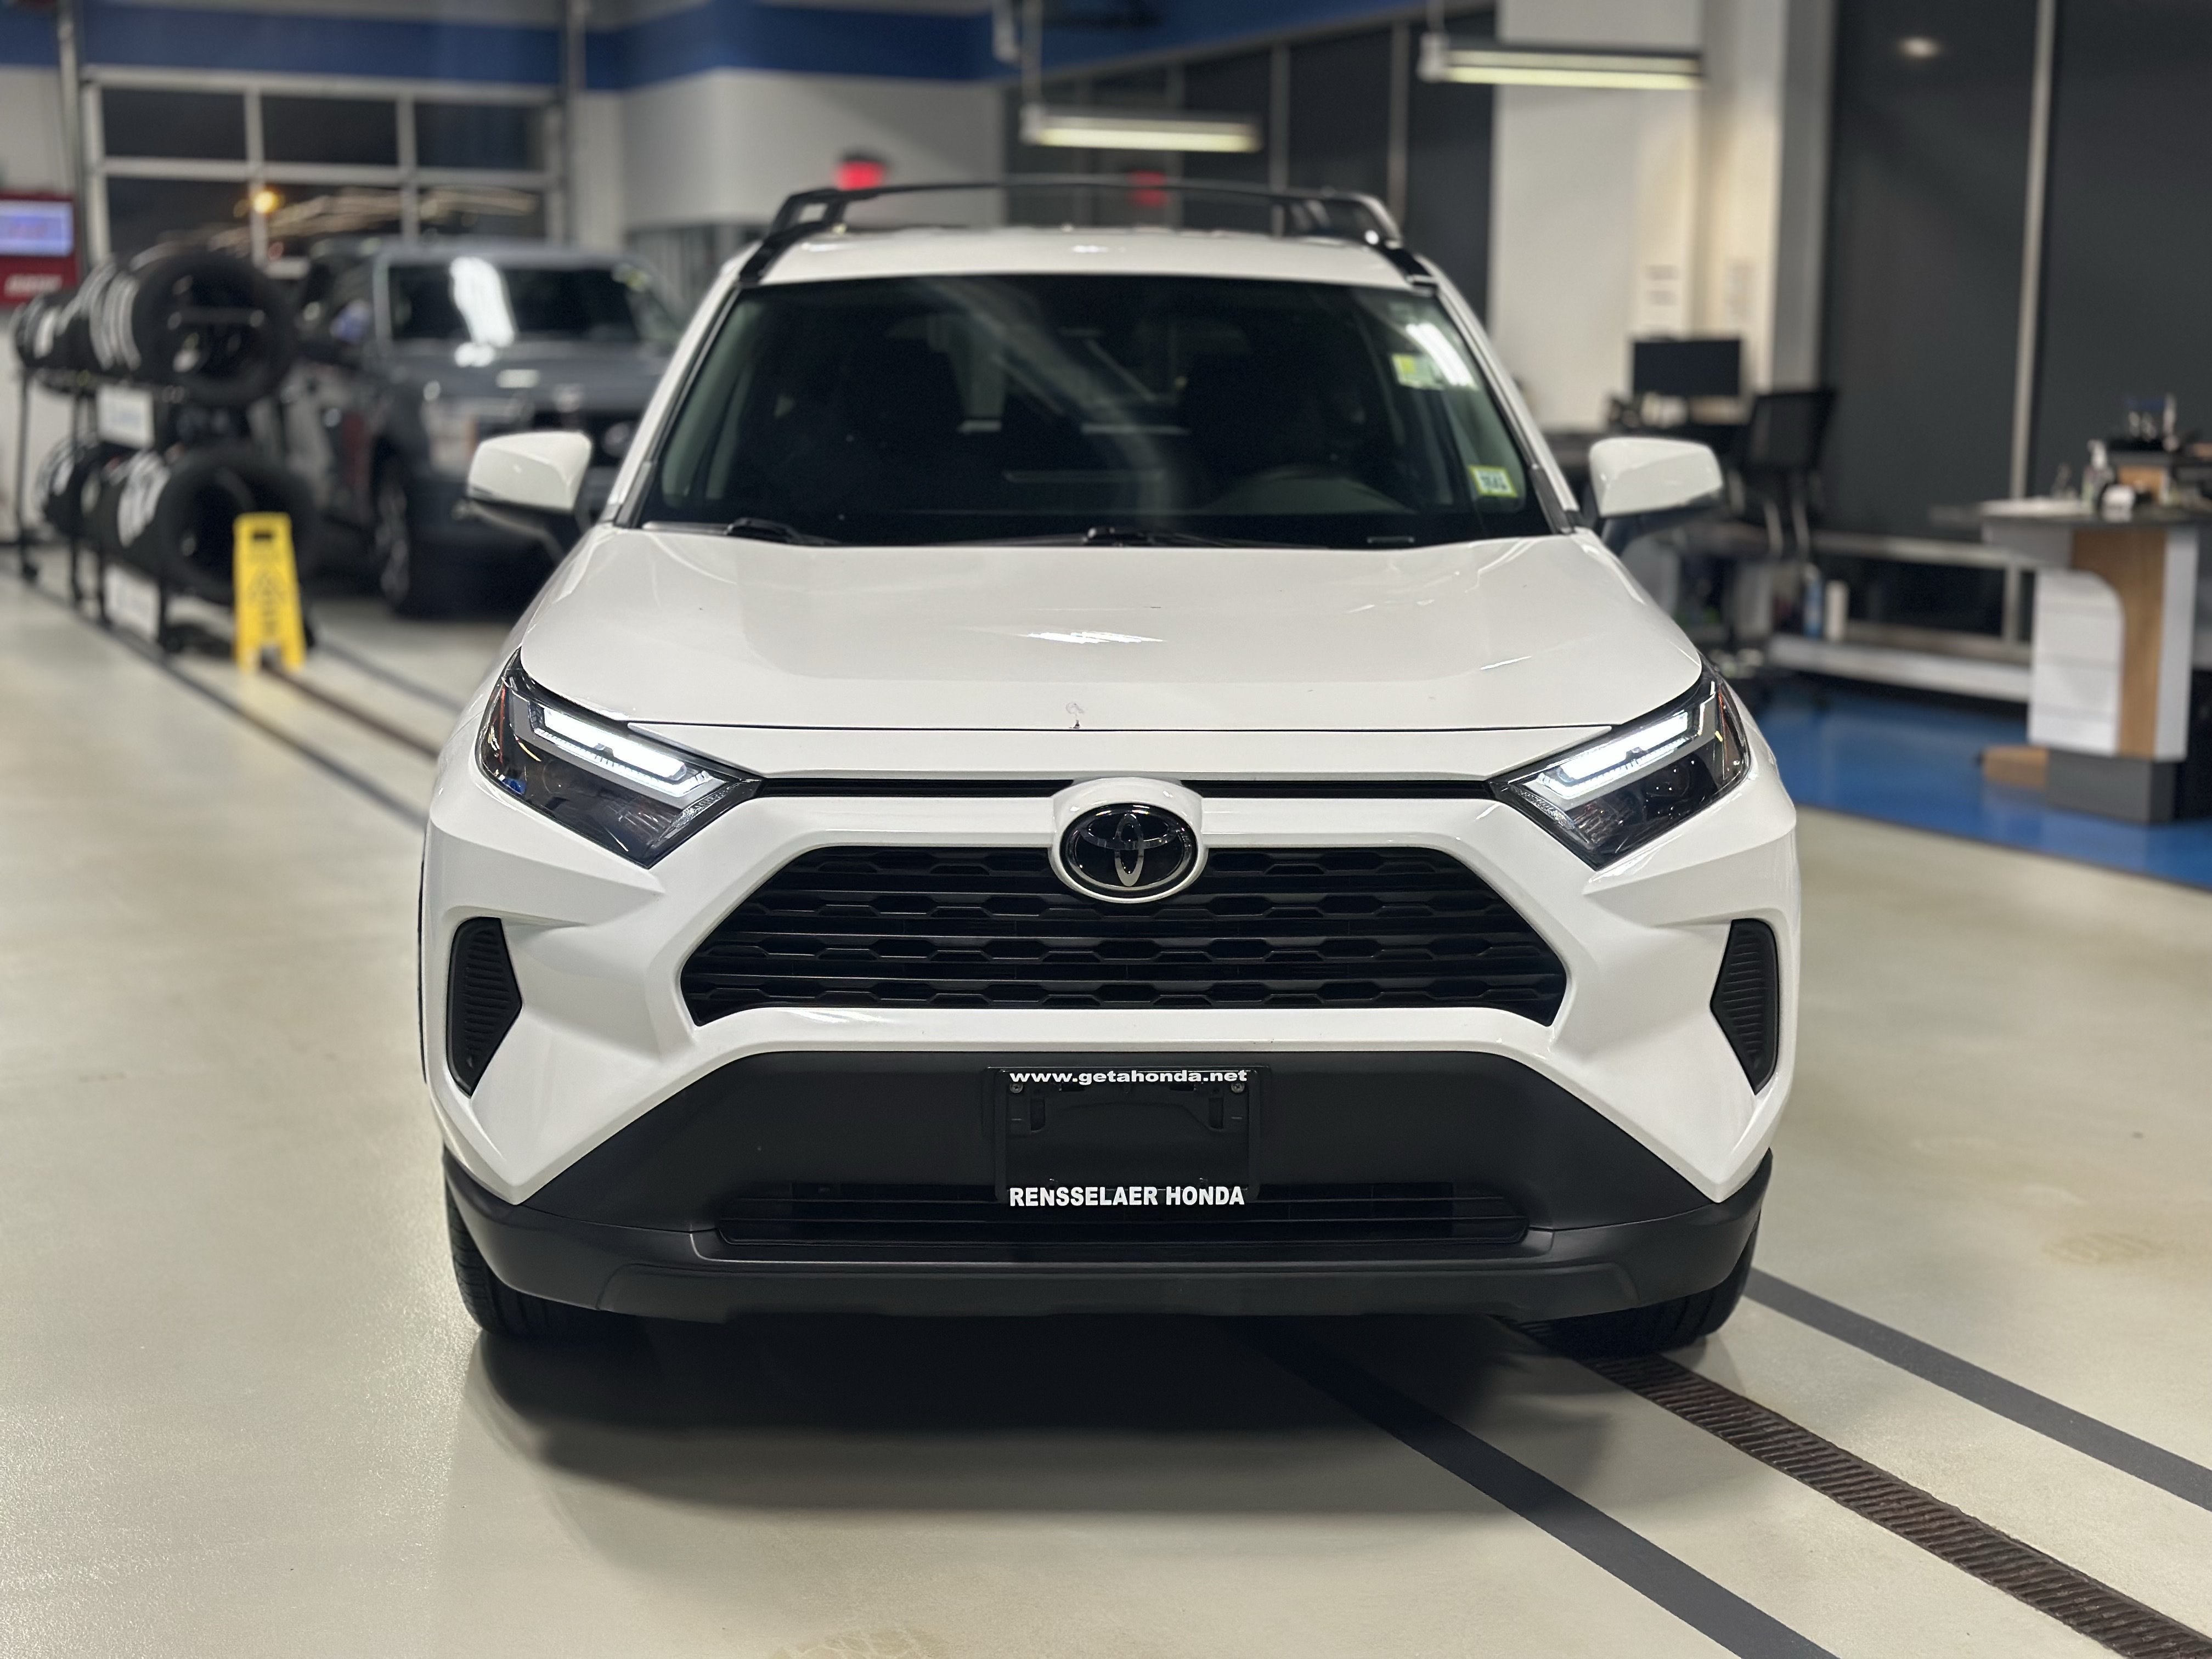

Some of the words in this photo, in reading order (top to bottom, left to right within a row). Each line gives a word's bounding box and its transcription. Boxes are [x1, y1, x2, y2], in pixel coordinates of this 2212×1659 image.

[1009, 1070, 1248, 1086] www.getahonda.net
[1009, 1186, 1158, 1206] RENSSELAER
[1166, 1186, 1245, 1206] HONDA
